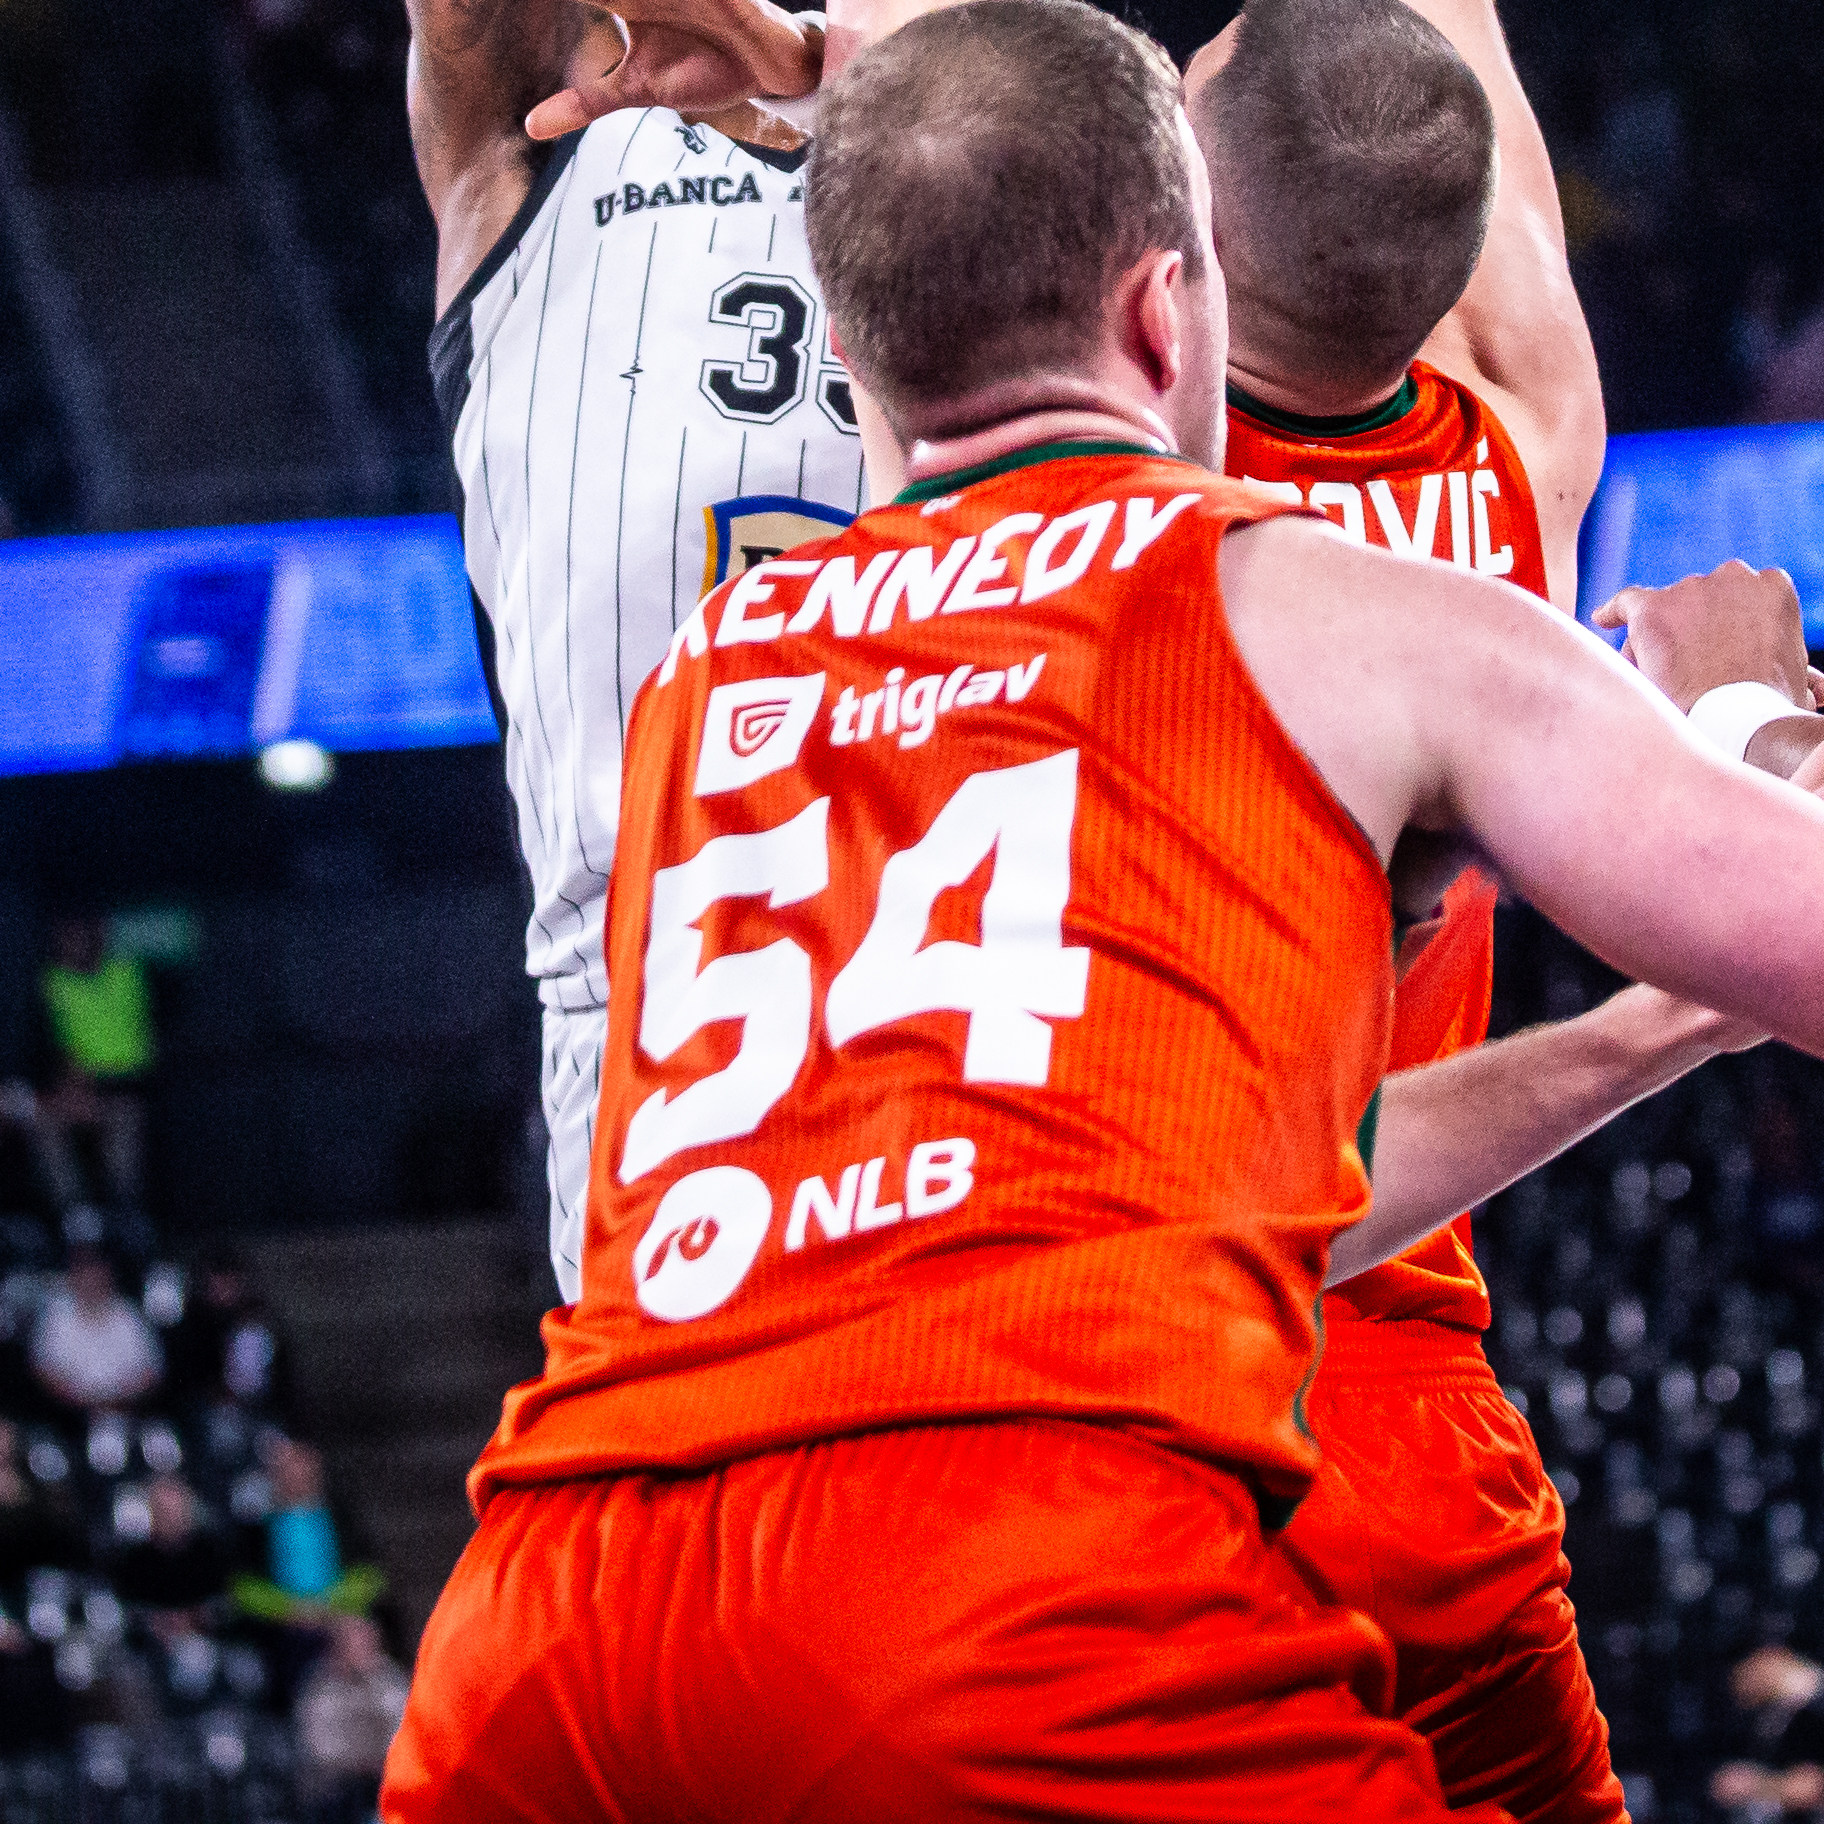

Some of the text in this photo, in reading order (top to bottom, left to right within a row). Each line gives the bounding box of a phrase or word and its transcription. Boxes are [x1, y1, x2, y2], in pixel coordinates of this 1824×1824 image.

[592, 170, 764, 228] U-BANCA
[828, 653, 1048, 752] triglav
[618, 746, 1091, 1186] 54
[783, 1136, 977, 1252] NLB
